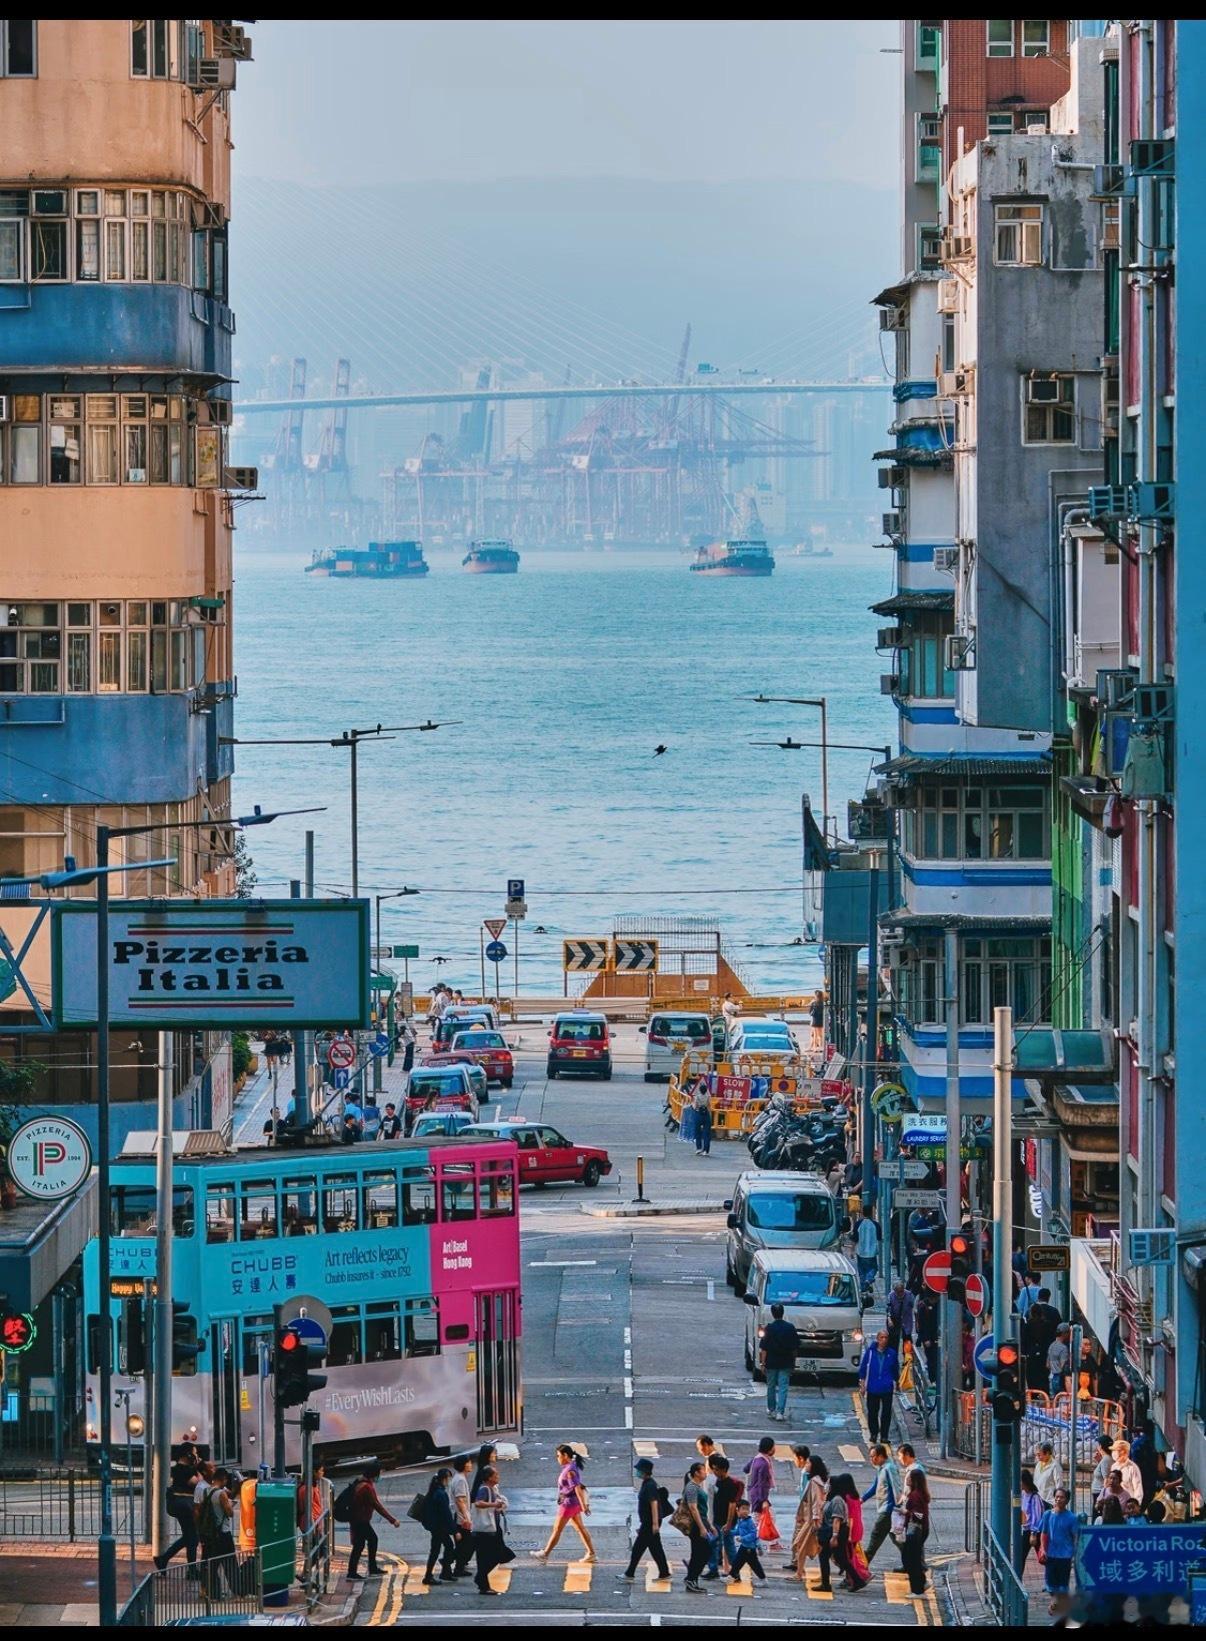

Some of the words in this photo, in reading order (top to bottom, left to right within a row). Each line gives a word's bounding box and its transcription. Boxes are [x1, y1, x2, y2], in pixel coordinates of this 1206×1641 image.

[511, 882, 522, 895] P
[113, 940, 309, 964] Pizzeria
[138, 968, 285, 991] Italia
[723, 1078, 745, 1087] SLOW
[26, 1126, 72, 1140] PIZZERIA
[32, 1180, 66, 1190] ITALIA
[110, 1247, 158, 1257] HUB
[325, 1251, 340, 1267] Art
[342, 1247, 377, 1265] reflects
[378, 1244, 409, 1265] legacy
[231, 1255, 297, 1274] CHUBB
[231, 1274, 297, 1295] 安達人壽
[325, 1271, 346, 1284] Chubb
[325, 1386, 416, 1413] #EveryWishLasts
[1099, 1536, 1168, 1552] Victoria
